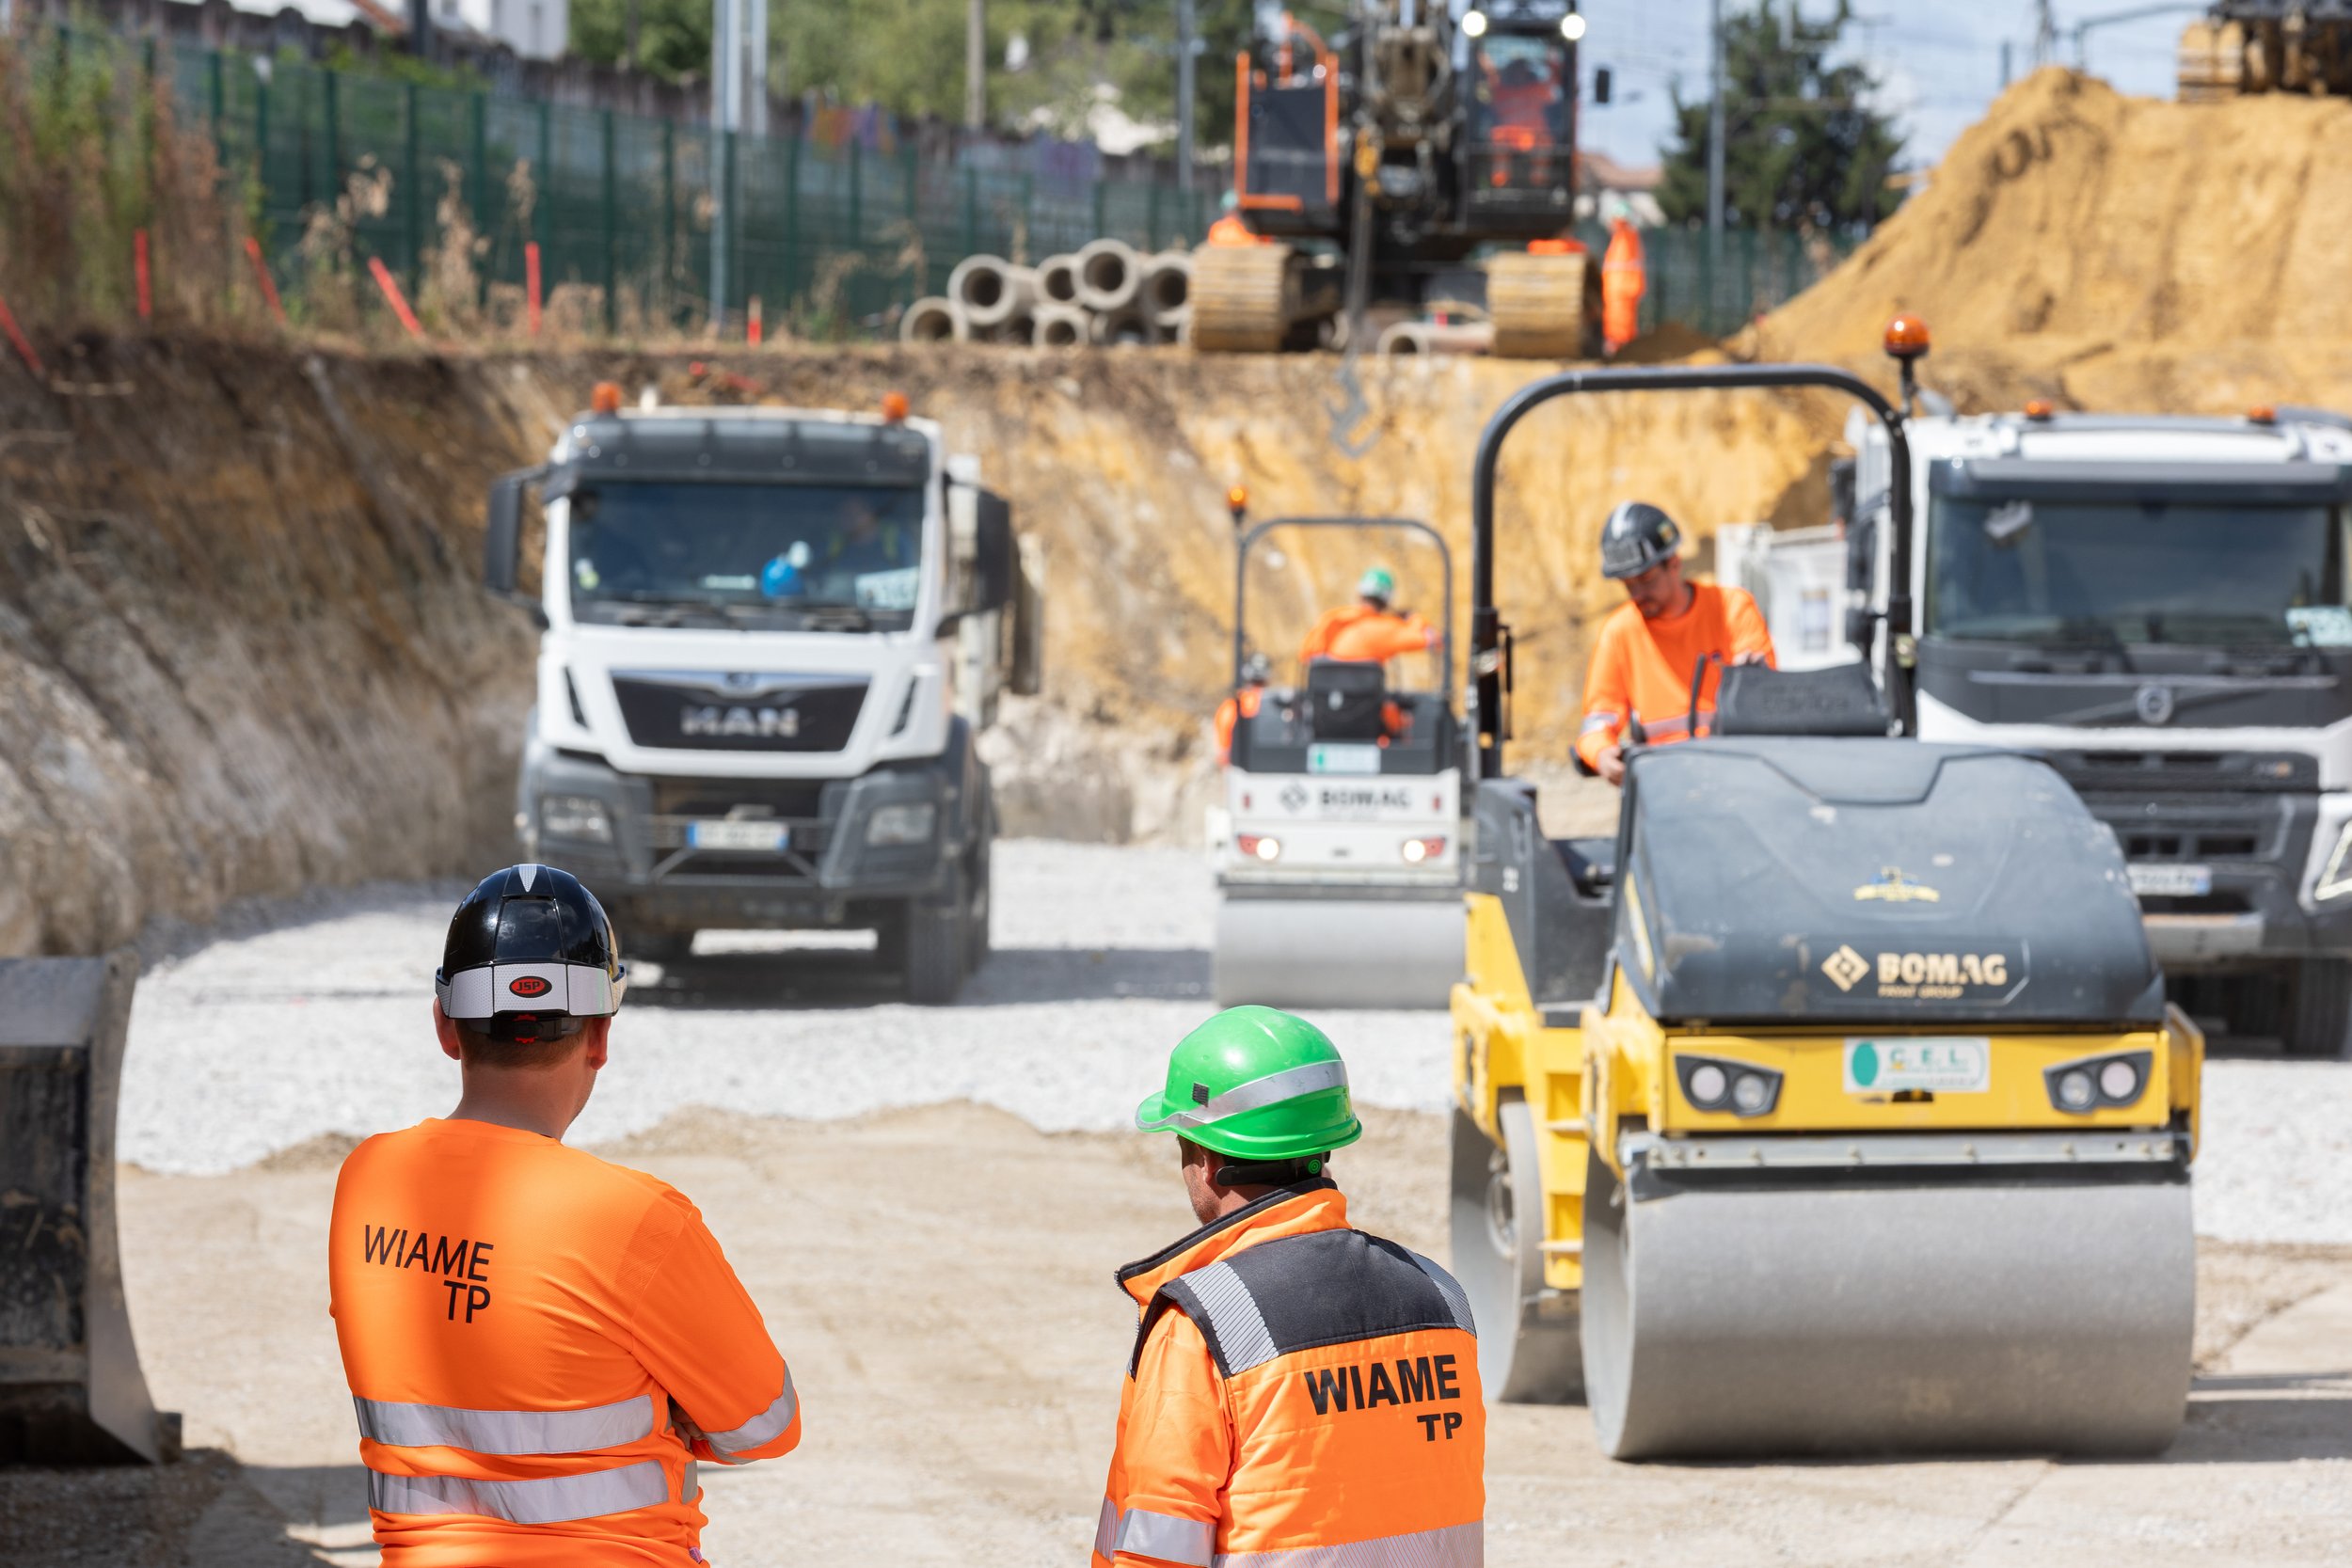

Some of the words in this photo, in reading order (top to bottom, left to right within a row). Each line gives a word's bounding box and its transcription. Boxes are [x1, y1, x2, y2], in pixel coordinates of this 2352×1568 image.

[680, 706, 799, 737] MAN
[1877, 953, 2007, 985] BOMAG
[516, 981, 540, 991] JSP
[365, 1225, 494, 1282] WIAME
[443, 1279, 491, 1323] TP
[1304, 1354, 1460, 1415] WIAME
[1417, 1412, 1463, 1441] TP
